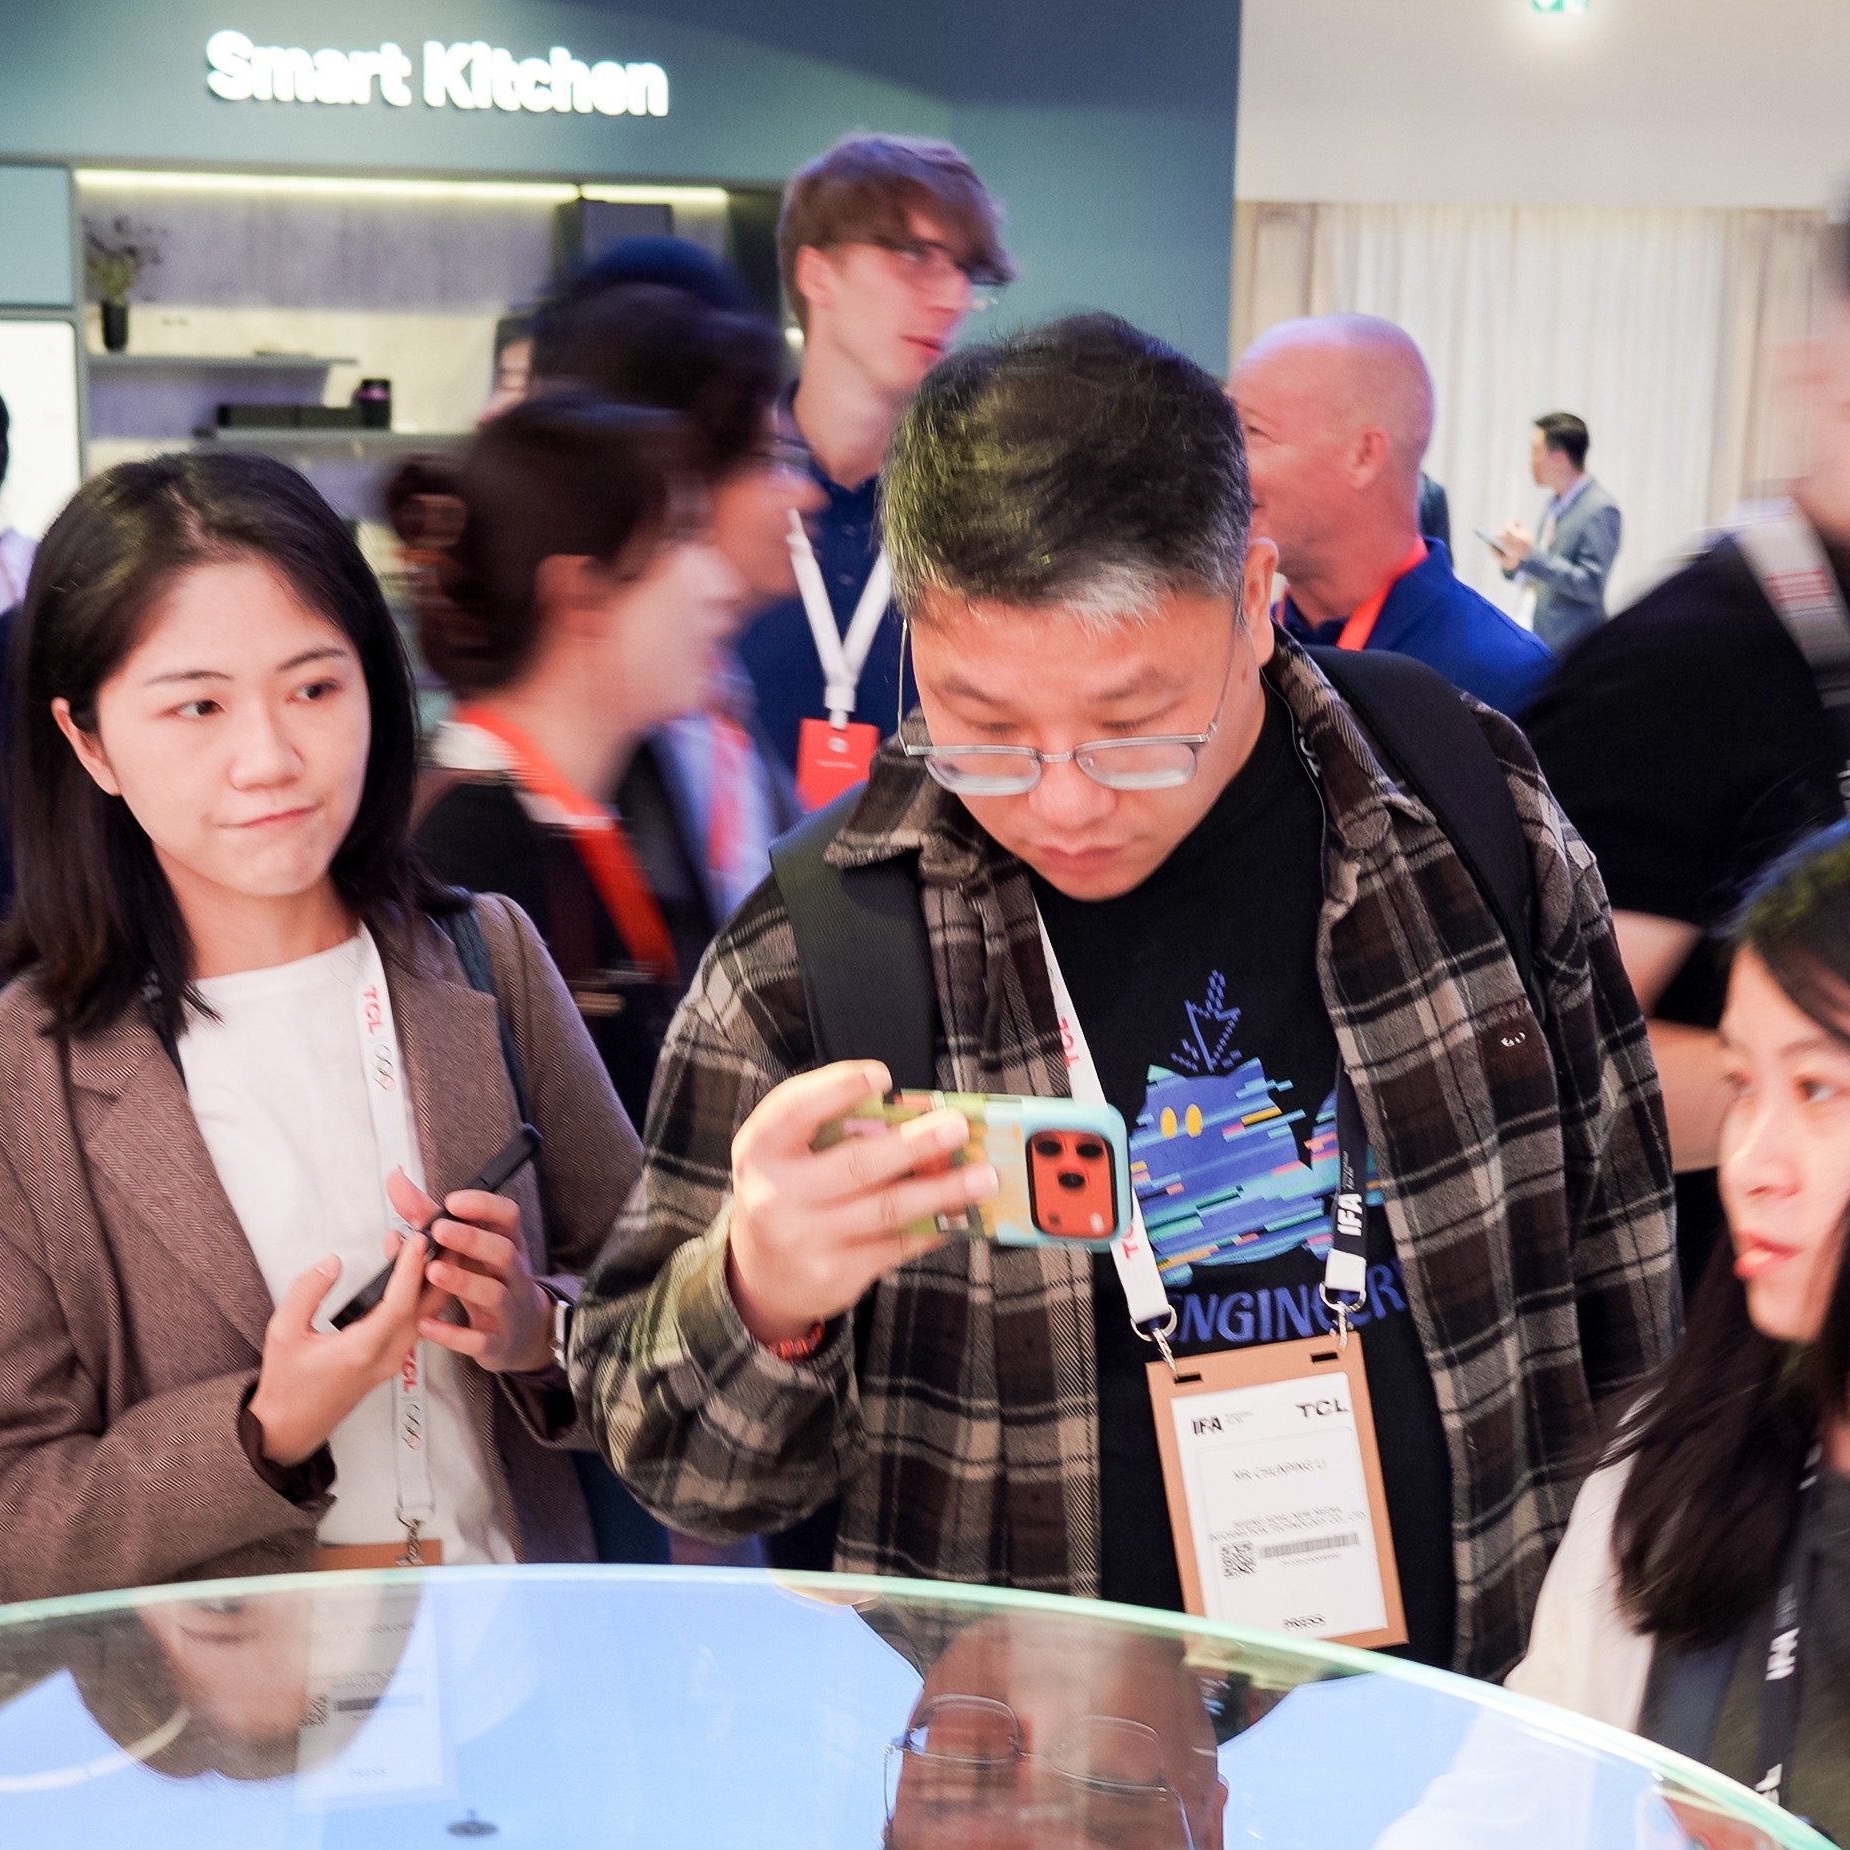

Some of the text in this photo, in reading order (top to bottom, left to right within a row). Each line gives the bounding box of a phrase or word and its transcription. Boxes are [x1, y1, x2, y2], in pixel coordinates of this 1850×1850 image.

[206, 30, 669, 117] Smart Kitchen
[364, 986, 381, 1034] TCL
[1337, 1193, 1364, 1237] IFA
[1295, 1397, 1350, 1420] TCL
